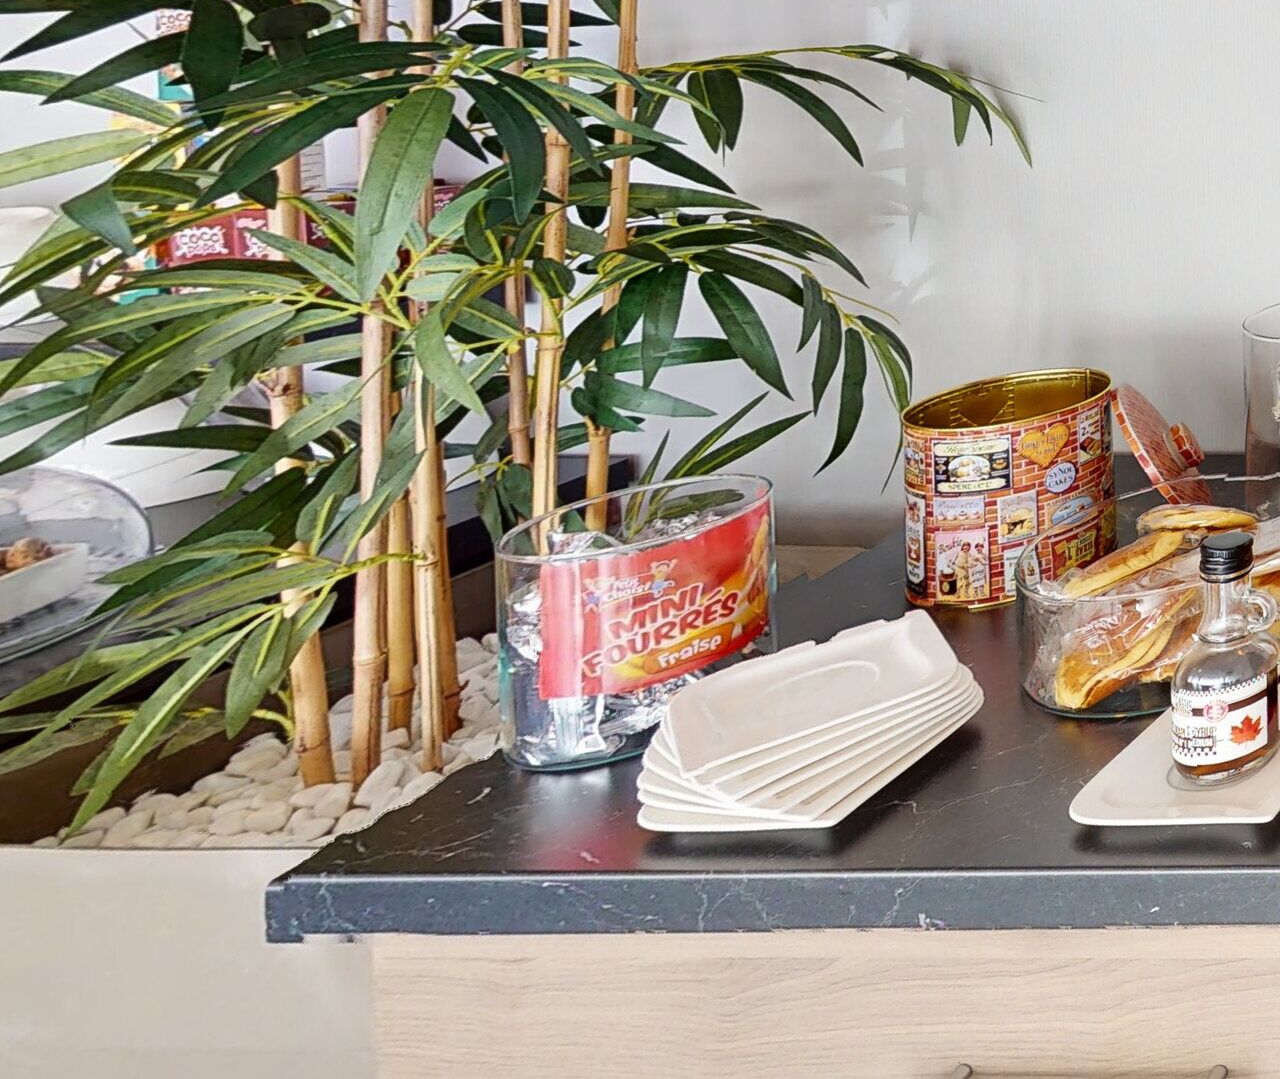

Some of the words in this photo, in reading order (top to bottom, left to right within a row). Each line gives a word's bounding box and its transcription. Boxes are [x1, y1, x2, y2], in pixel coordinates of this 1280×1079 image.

[180, 231, 221, 246] COCO
[580, 587, 740, 678] FOURRÉS
[607, 582, 703, 641] MINI
[657, 634, 722, 668] Fraise
